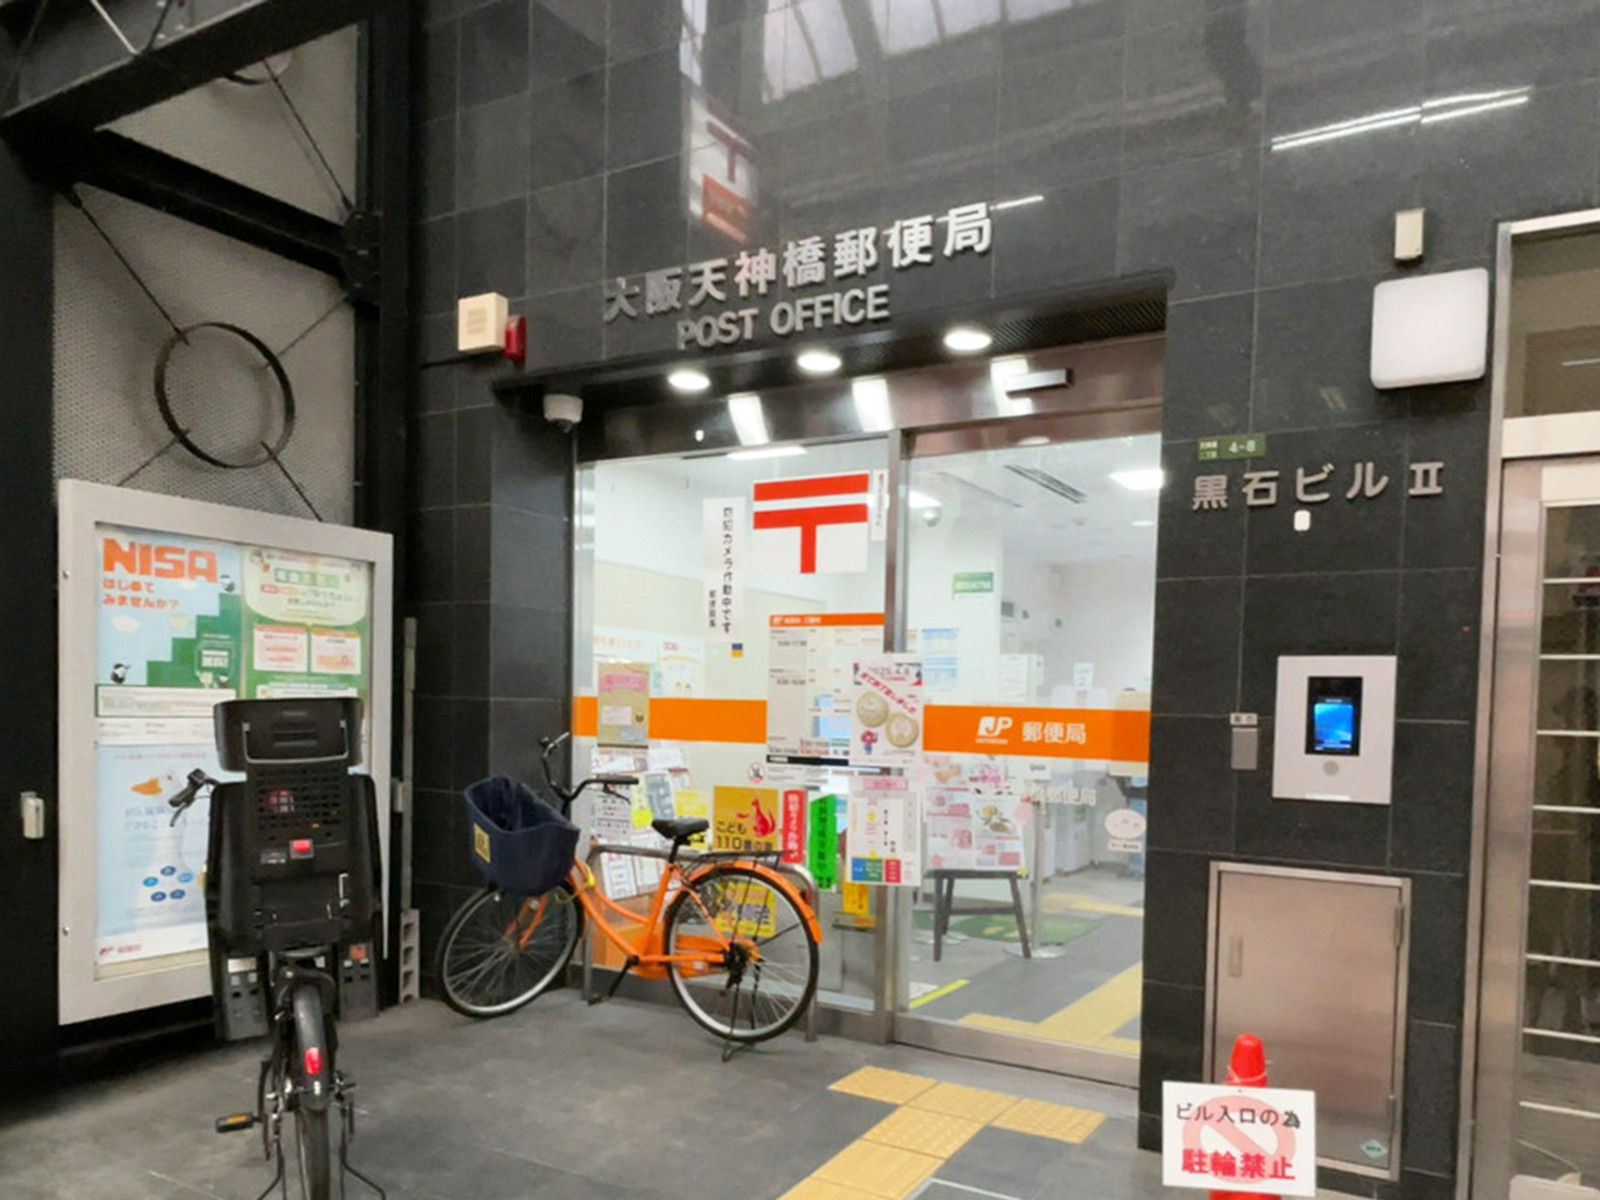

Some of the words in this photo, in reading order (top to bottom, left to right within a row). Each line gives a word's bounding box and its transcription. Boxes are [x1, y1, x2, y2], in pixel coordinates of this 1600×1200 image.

[603, 202, 992, 322] 大阪天神橋郵便局
[676, 308, 759, 351] POST
[771, 284, 890, 335] OFFICE
[102, 537, 218, 584] NISA
[102, 578, 156, 595] はじめて
[1021, 721, 1086, 745] 郵便局
[716, 821, 747, 835] こども
[1176, 1102, 1301, 1129] ビル入口の為
[1181, 1148, 1296, 1181] 駐輪禁止
